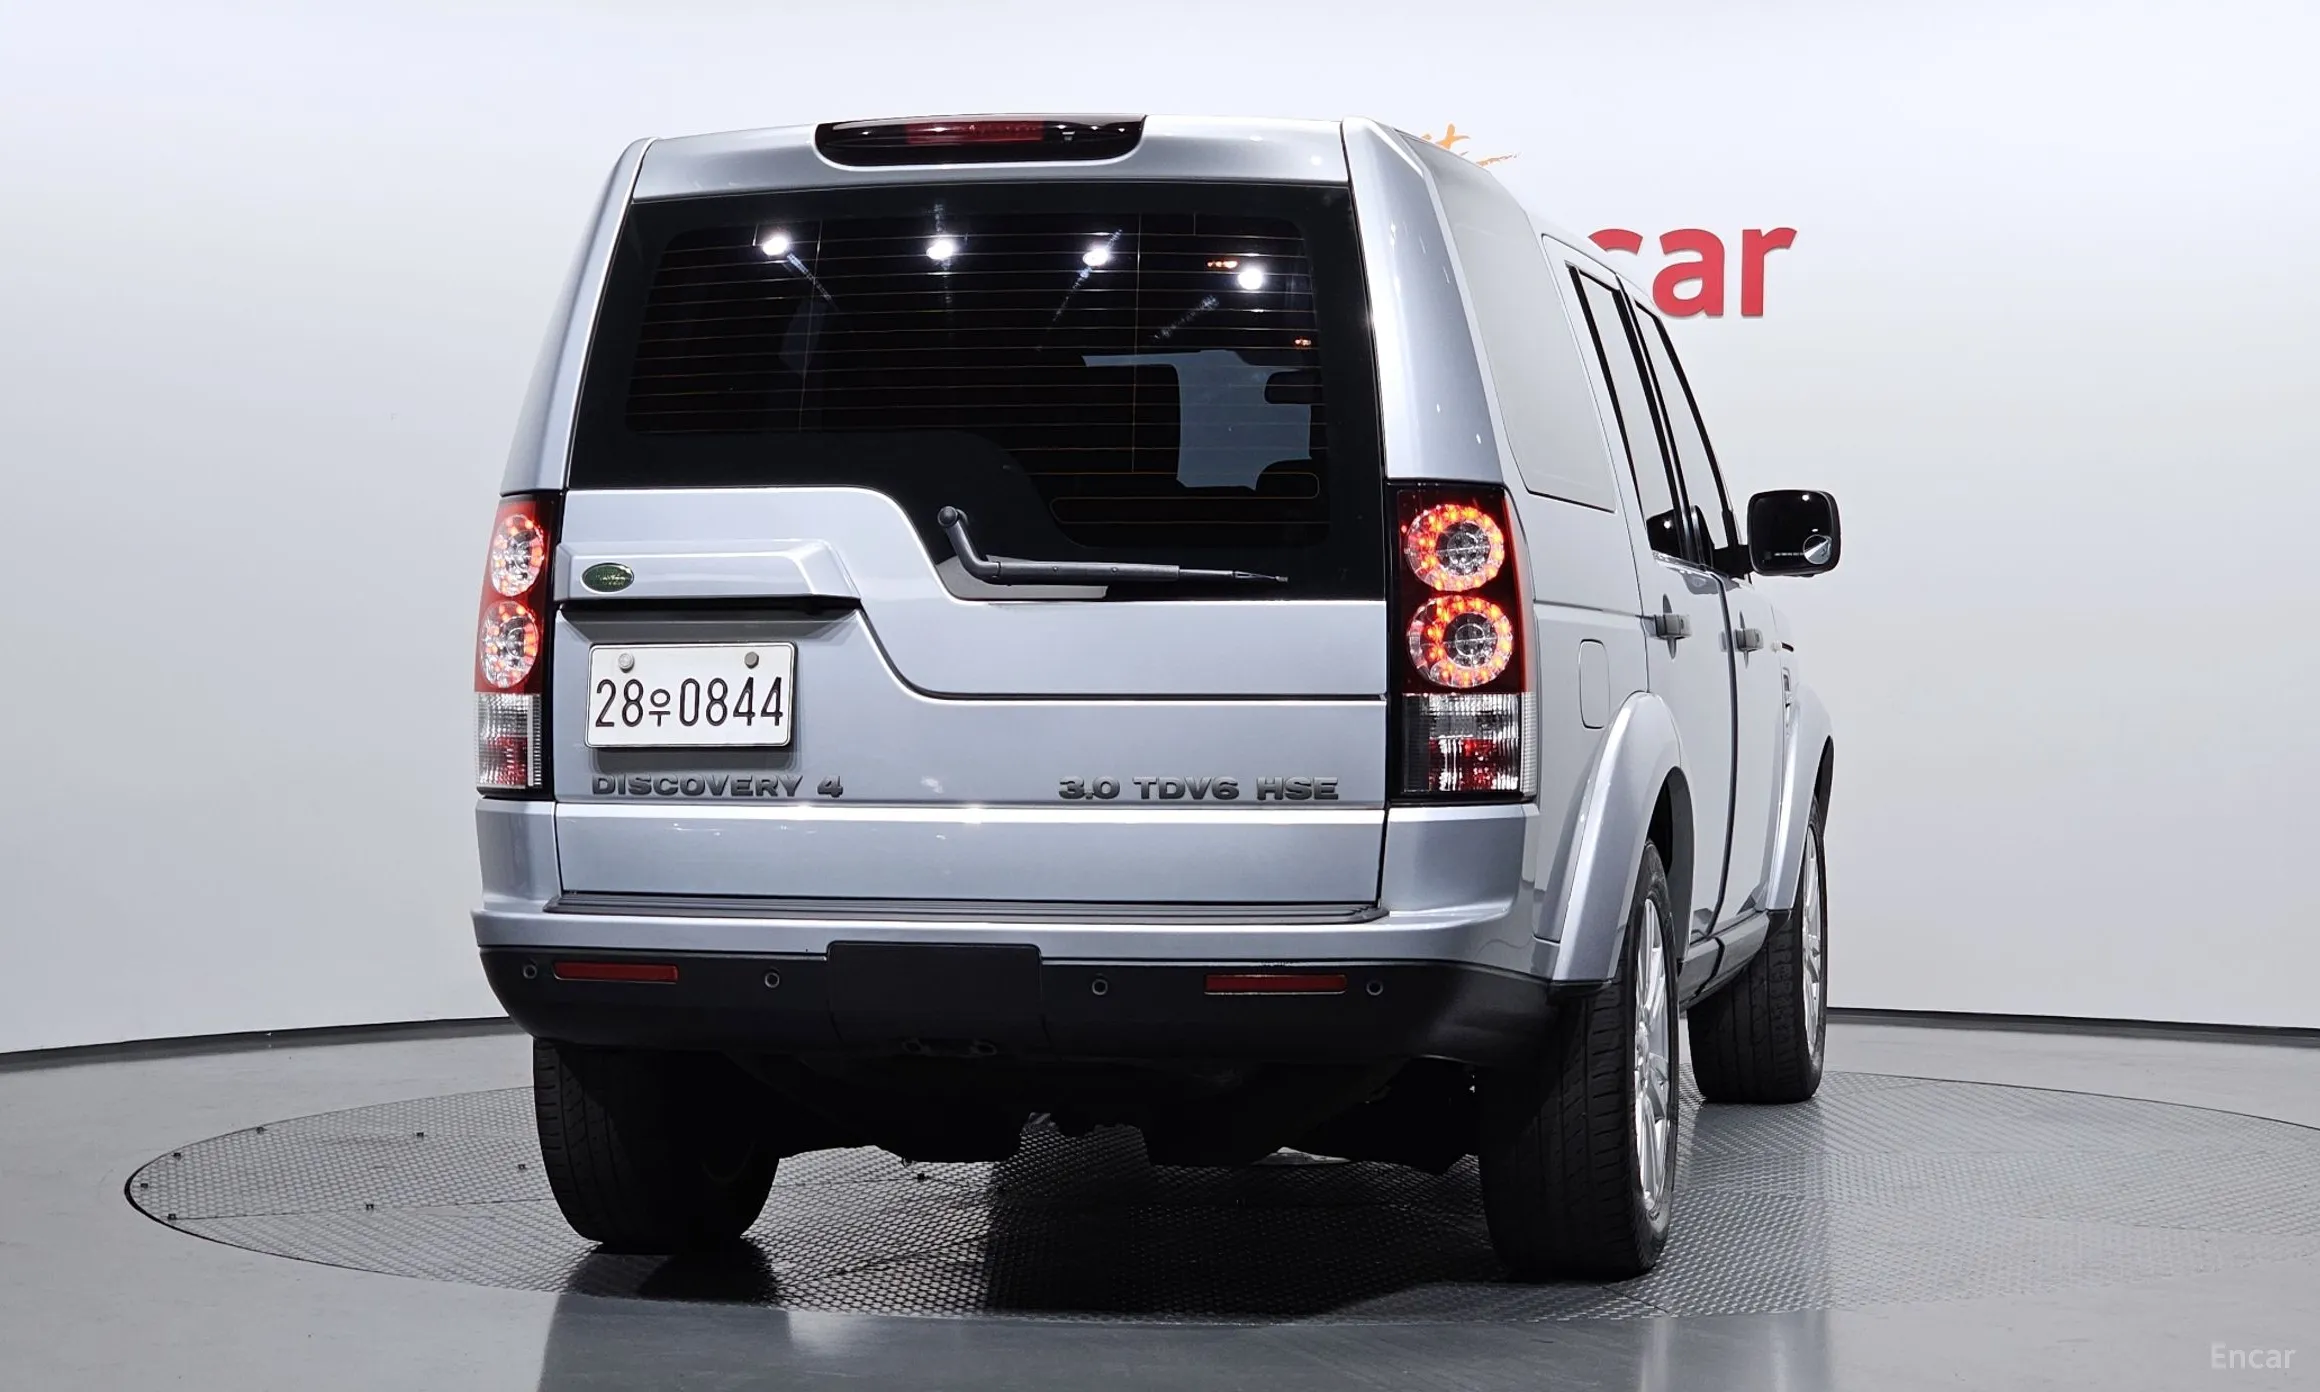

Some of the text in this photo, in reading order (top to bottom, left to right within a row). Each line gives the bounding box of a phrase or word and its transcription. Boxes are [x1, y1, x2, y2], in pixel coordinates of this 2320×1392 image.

[595, 676, 783, 727] 28우0844
[592, 775, 844, 798] DISCOVERY 4
[1058, 776, 1339, 800] 3.0 TDV6 HSE
